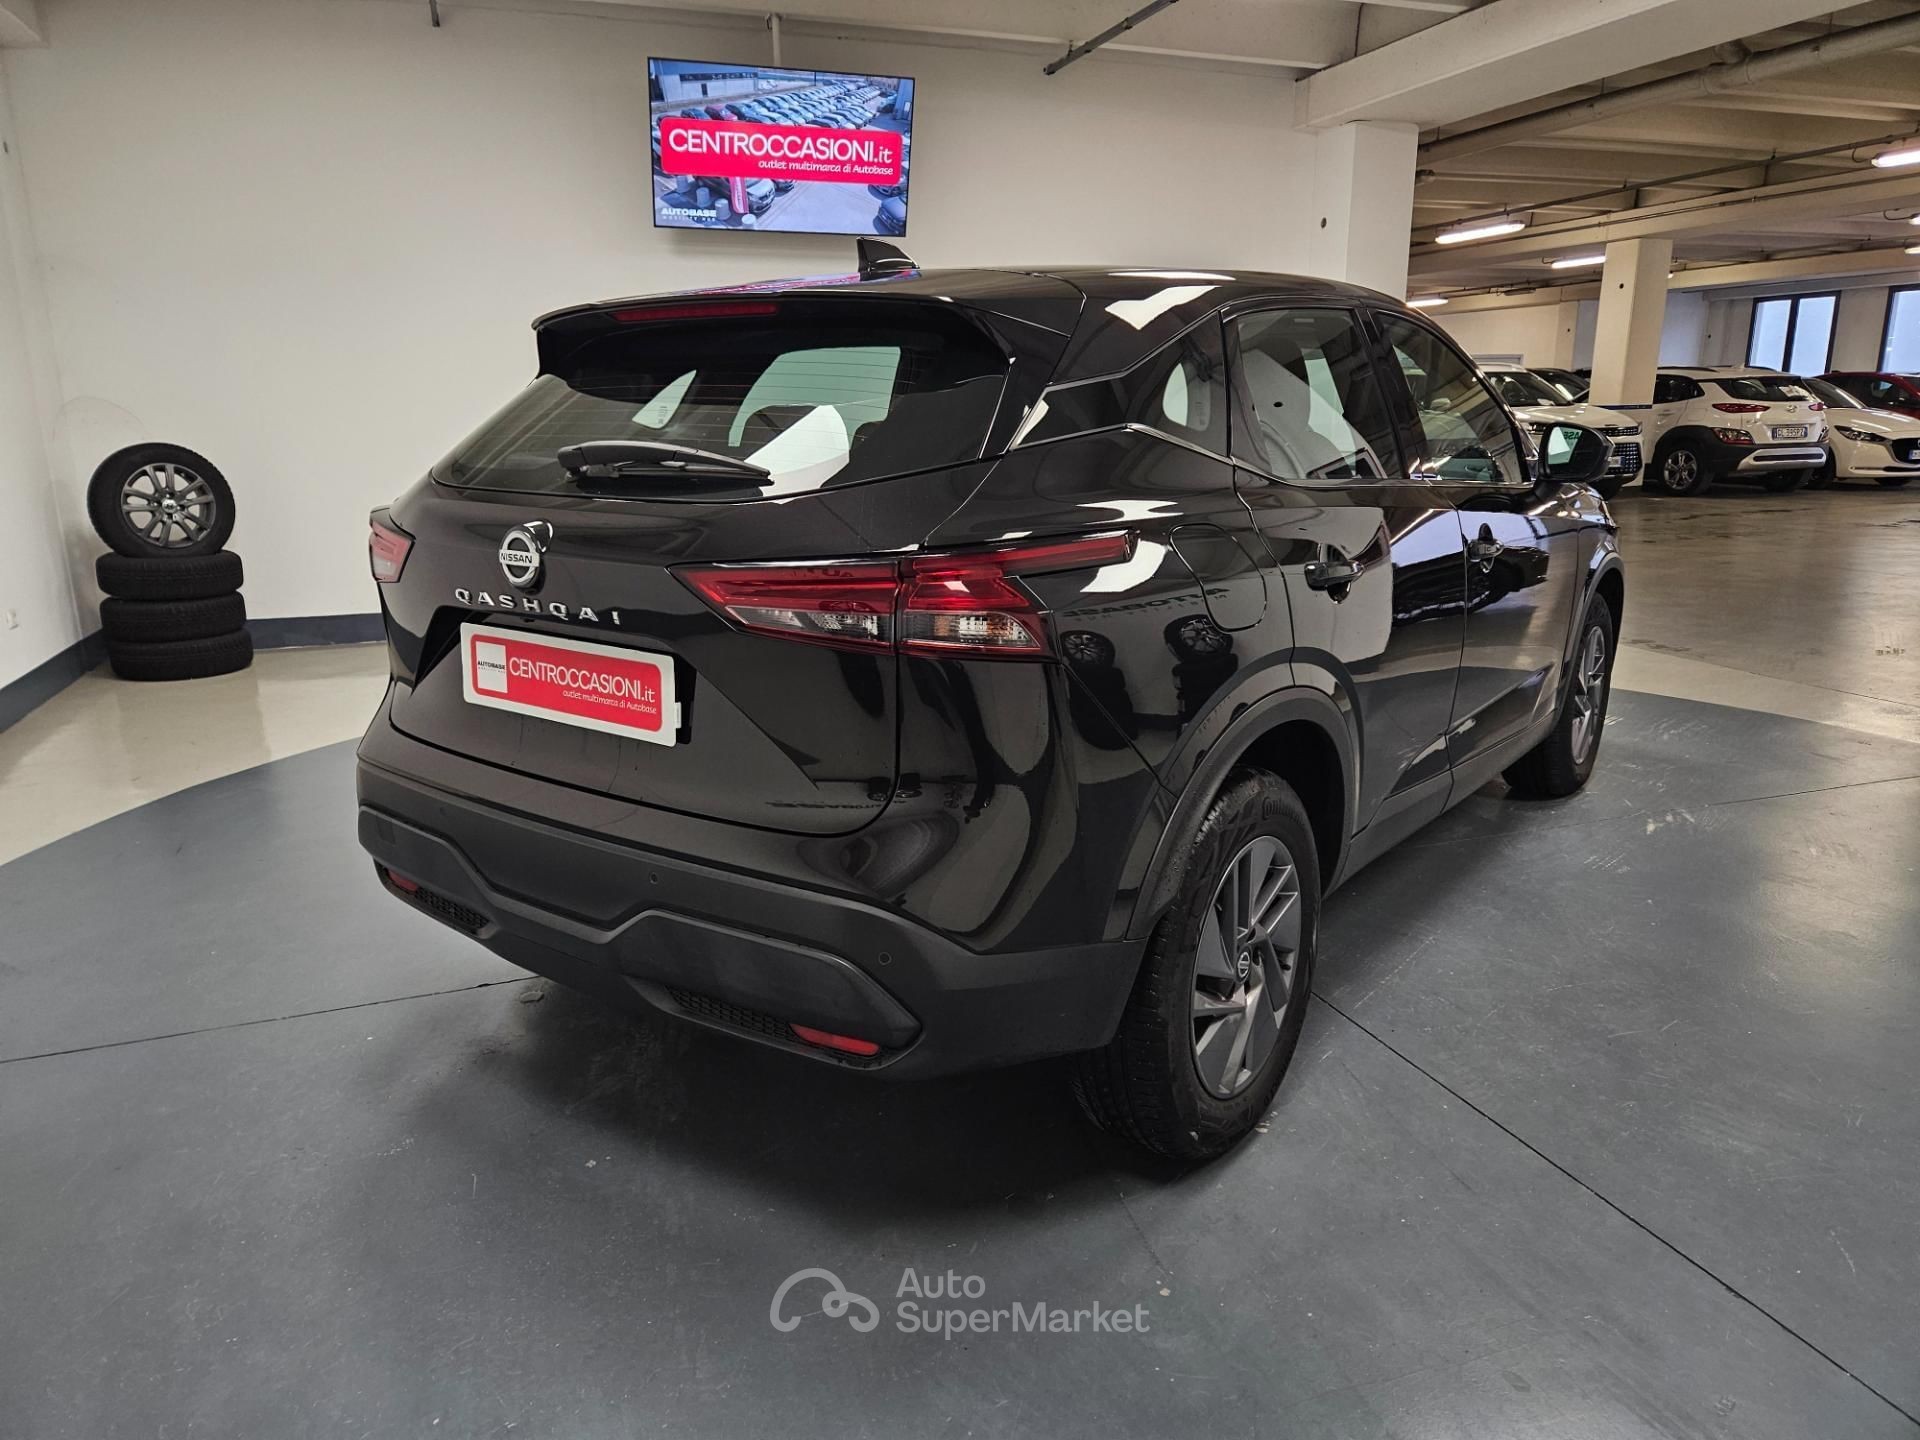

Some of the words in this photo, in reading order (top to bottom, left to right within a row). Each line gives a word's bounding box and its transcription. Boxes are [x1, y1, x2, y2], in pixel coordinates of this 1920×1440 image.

[668, 128, 893, 164] CENTROCCASIONI.it
[758, 159, 787, 170] outlet
[789, 161, 840, 173] multimarca
[843, 163, 851, 173] di
[853, 164, 893, 175] Autobase
[661, 207, 717, 217] AUTOBASE
[501, 552, 532, 564] NISSAN
[455, 588, 621, 625] QASHQAI
[509, 657, 656, 703] CENTROCCASIONI.it
[562, 690, 581, 700] outlet
[582, 693, 618, 707] multimarca
[620, 700, 626, 708] di
[626, 701, 657, 714] Autobase
